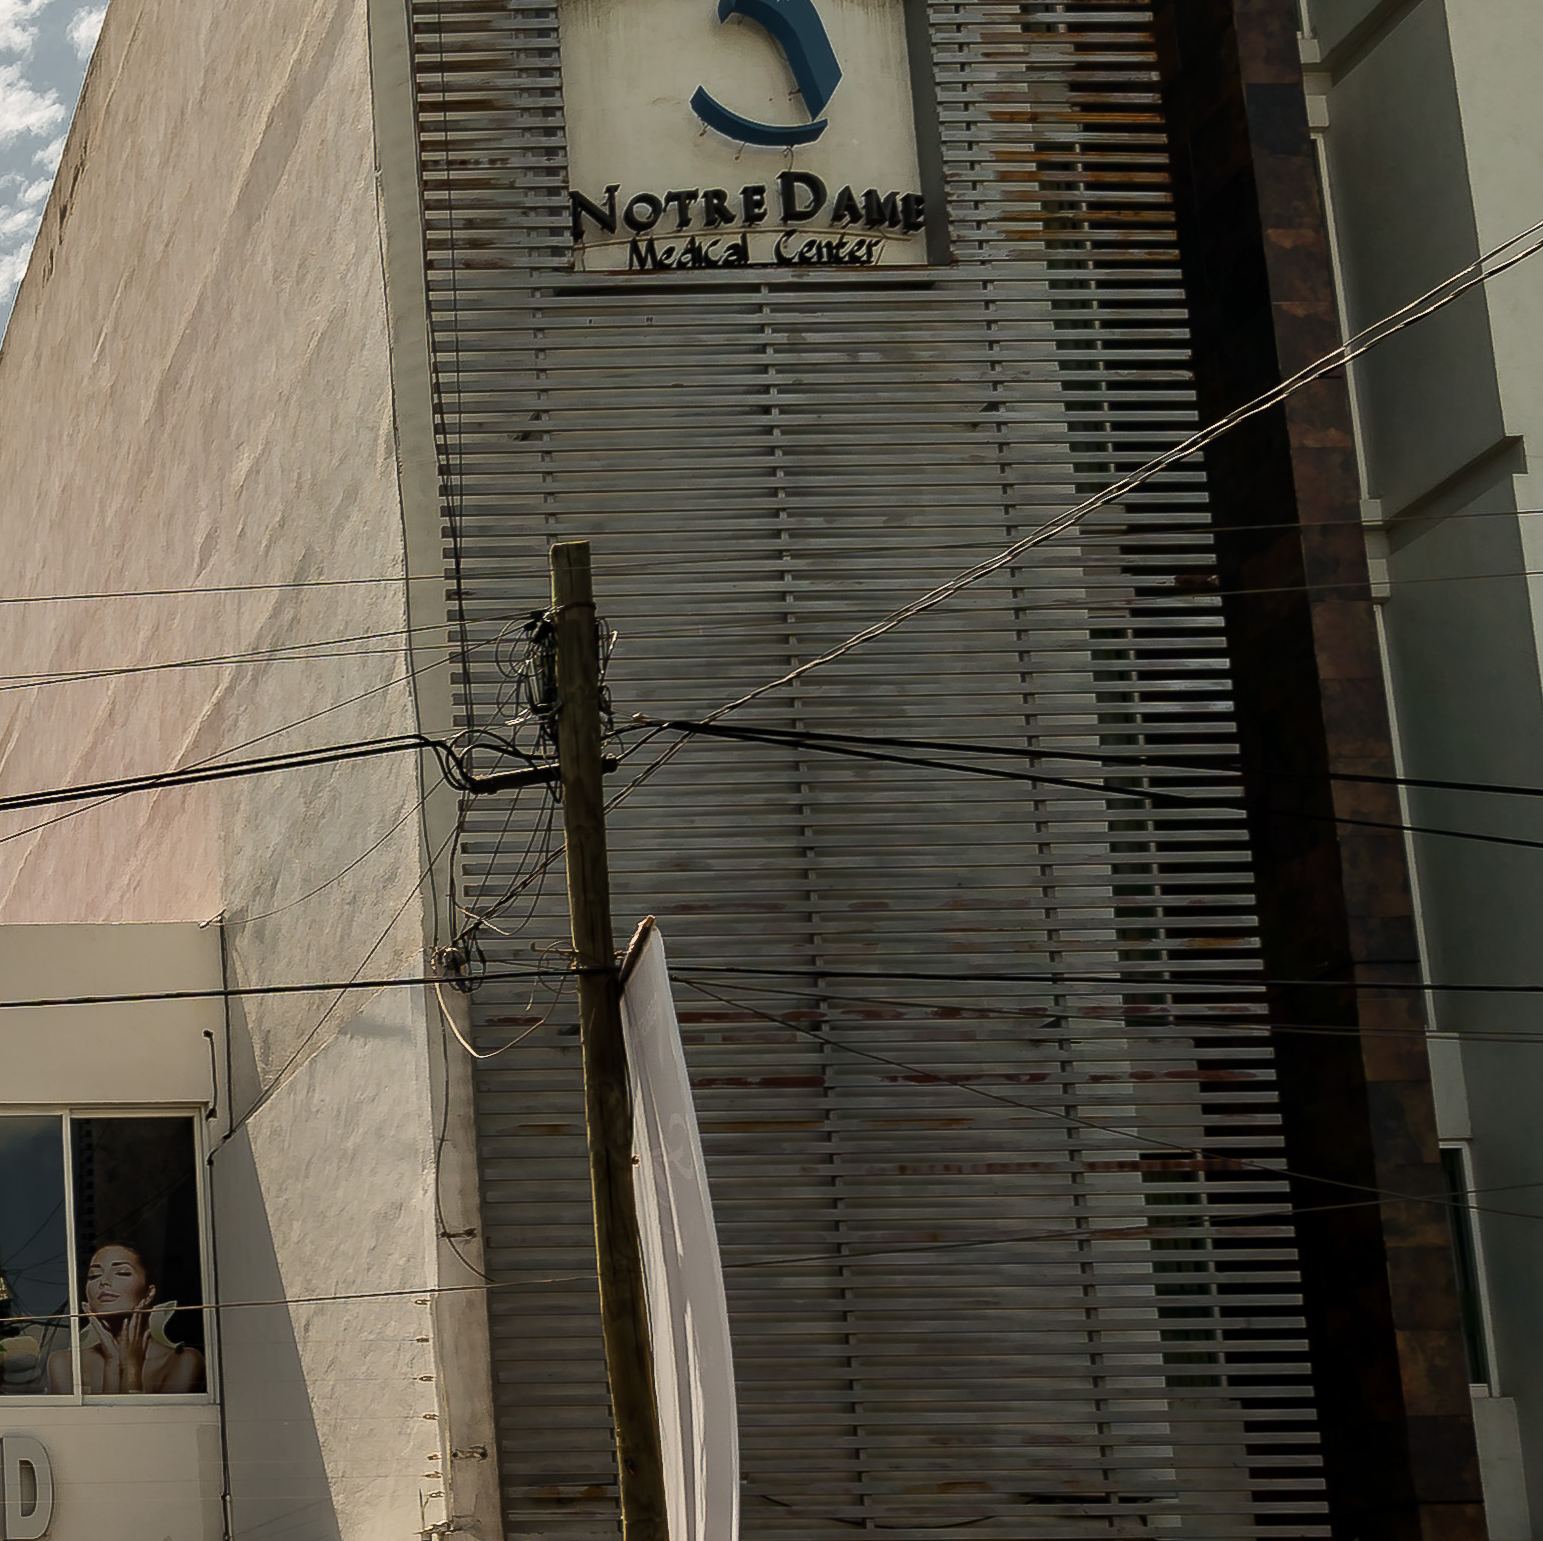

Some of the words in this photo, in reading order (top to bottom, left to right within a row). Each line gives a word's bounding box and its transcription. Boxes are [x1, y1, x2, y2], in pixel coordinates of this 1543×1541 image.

[569, 183, 767, 241] NOTRE
[776, 171, 927, 235] DAME
[629, 232, 748, 270] Medical
[774, 229, 885, 266] Center
